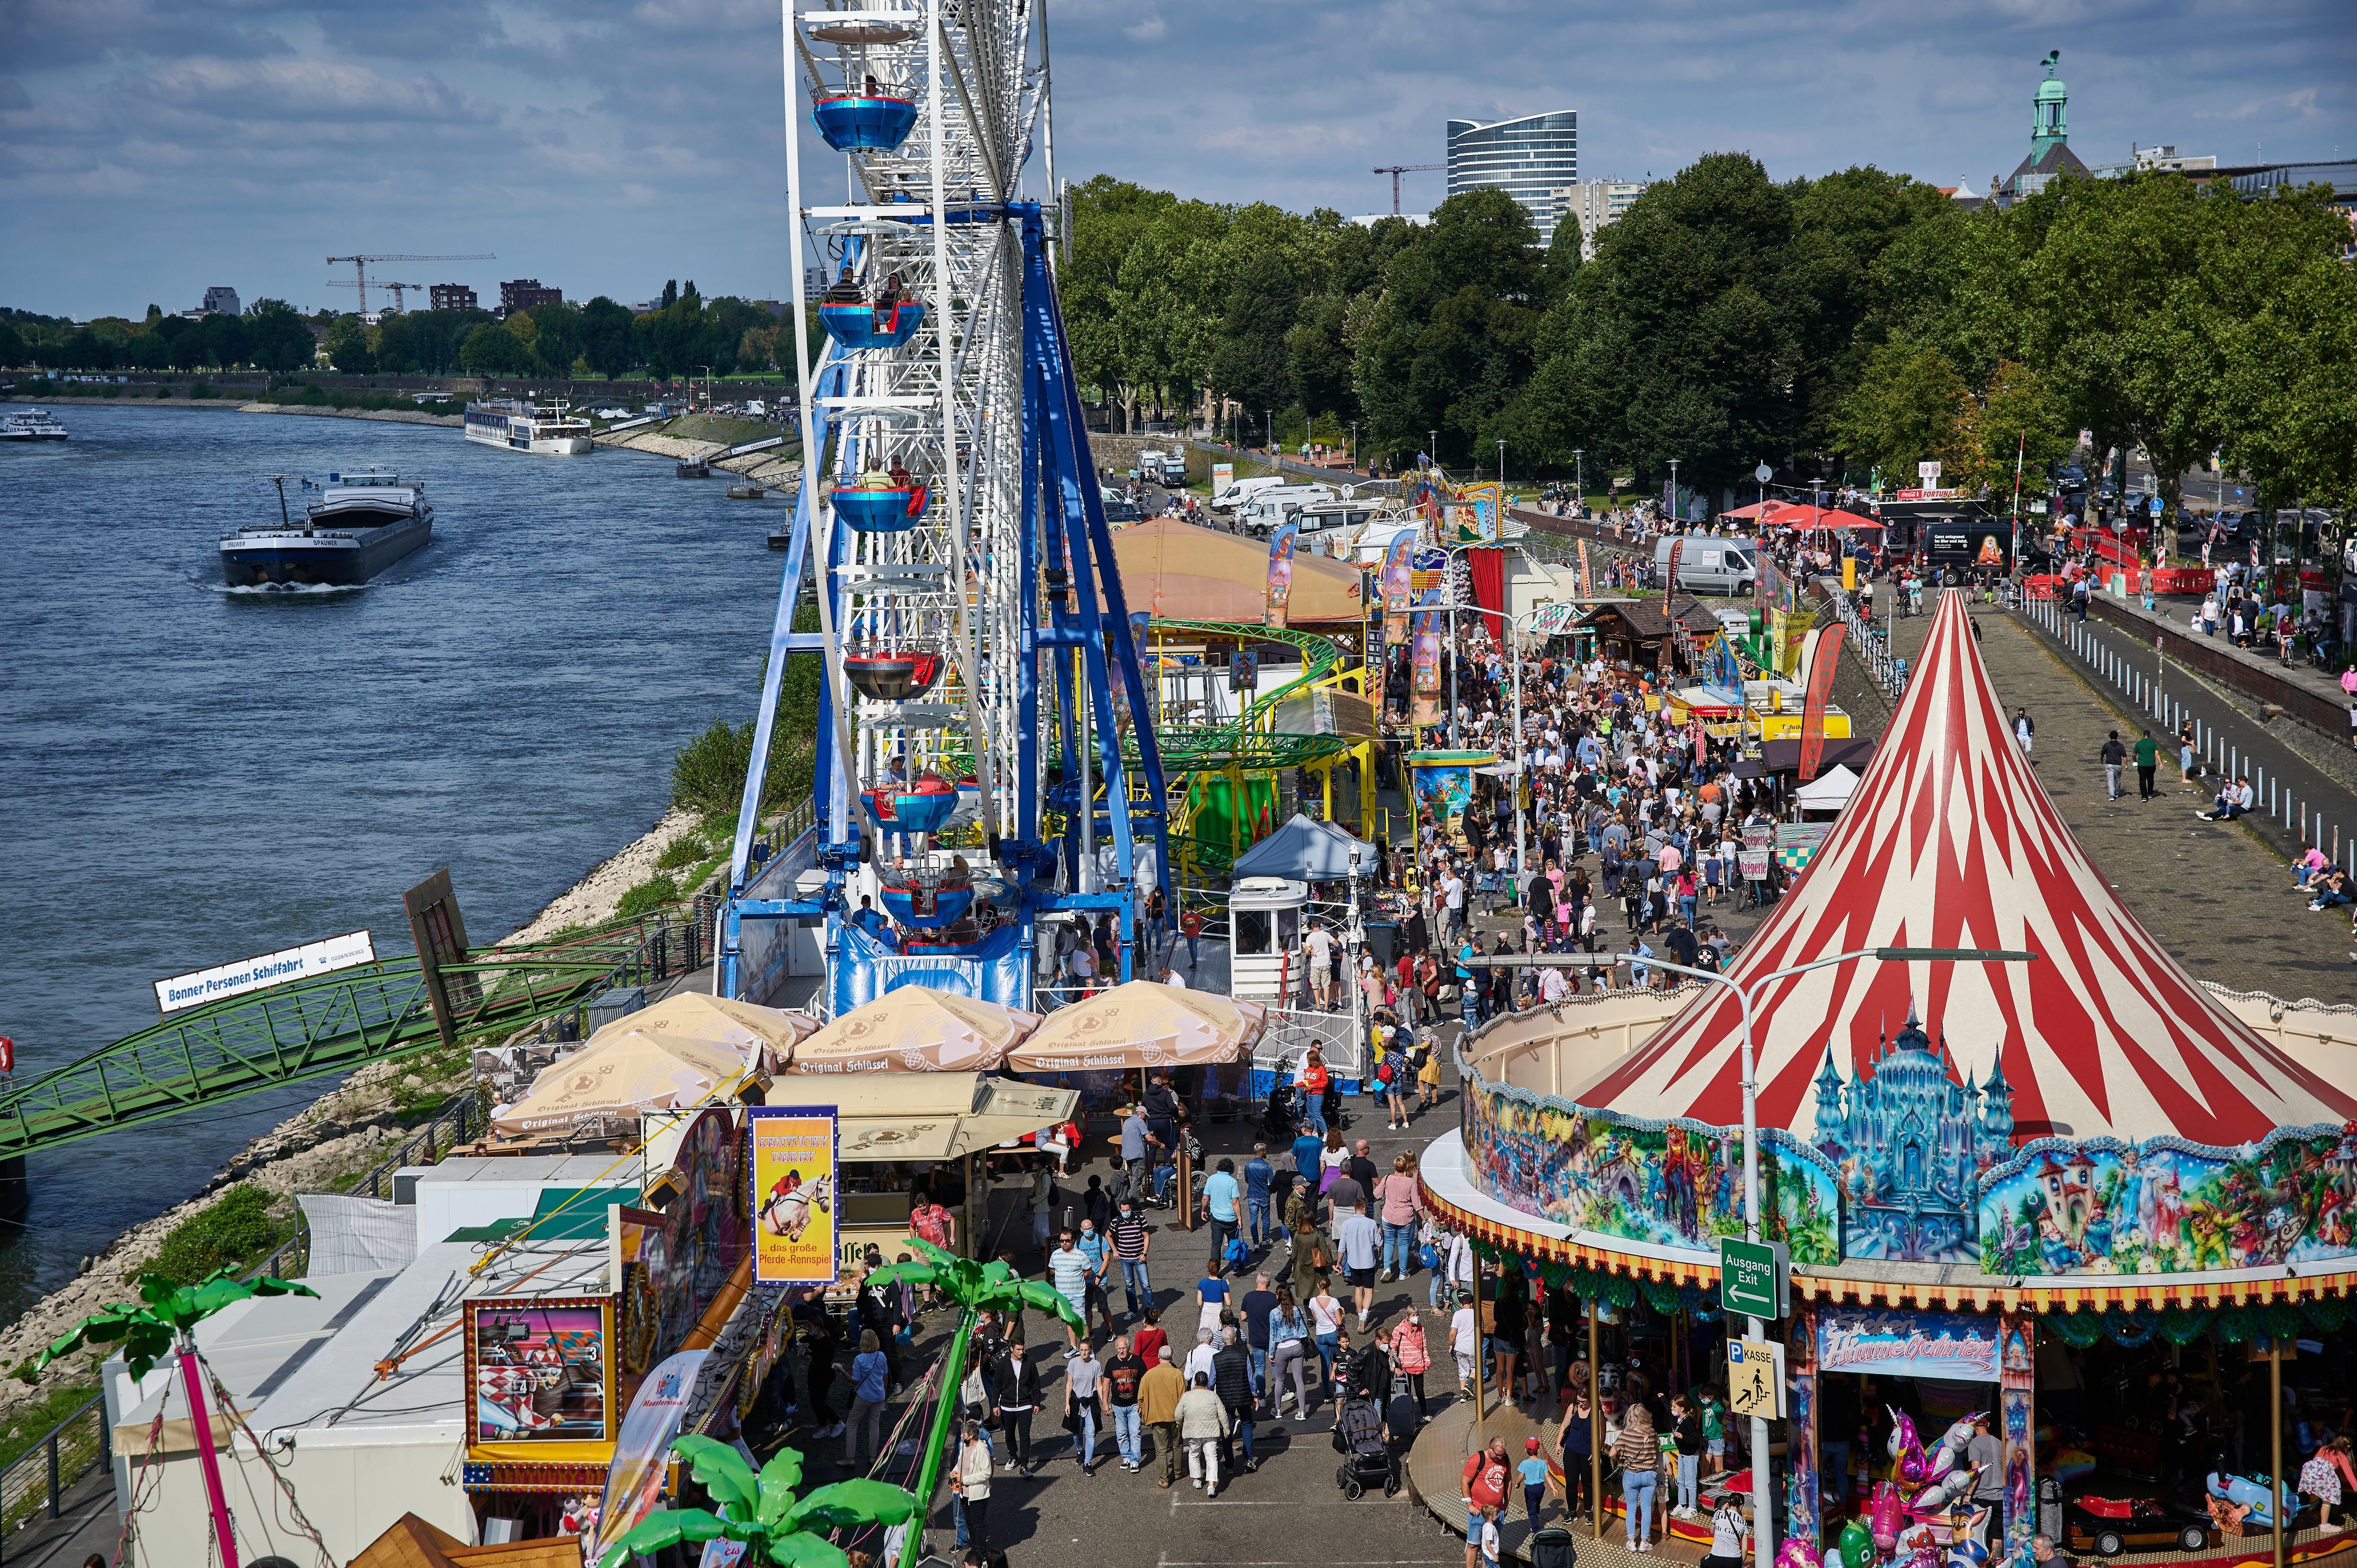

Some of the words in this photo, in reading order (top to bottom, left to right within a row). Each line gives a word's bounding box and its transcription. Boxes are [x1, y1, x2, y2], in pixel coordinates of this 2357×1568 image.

[1698, 852, 1722, 860] Airbsh
[1741, 860, 1767, 876] Crêperie
[169, 983, 204, 1002] Bonner
[206, 970, 252, 993] Personen
[253, 957, 304, 981] Schiffahrt
[331, 949, 365, 961] 0228/636363
[799, 1061, 843, 1075] Original
[846, 1057, 889, 1072] Schlüssel
[1035, 1056, 1080, 1069] Original
[1082, 1052, 1125, 1067] Schlüssel
[521, 1115, 568, 1130] Original
[757, 1135, 829, 1148] KENTUCKY
[771, 1151, 816, 1163] DERBY
[790, 1244, 817, 1254] große
[759, 1254, 785, 1264] Pferde
[787, 1254, 831, 1266] -Rennspiel
[1725, 1253, 1771, 1276] Ausgang
[1738, 1271, 1758, 1286] Exit
[590, 1346, 597, 1361] 3
[1731, 1343, 1742, 1361] P
[1744, 1349, 1771, 1364] KASSE
[520, 1379, 527, 1394] 4
[493, 1467, 606, 1485] KENTUCKY-DE
